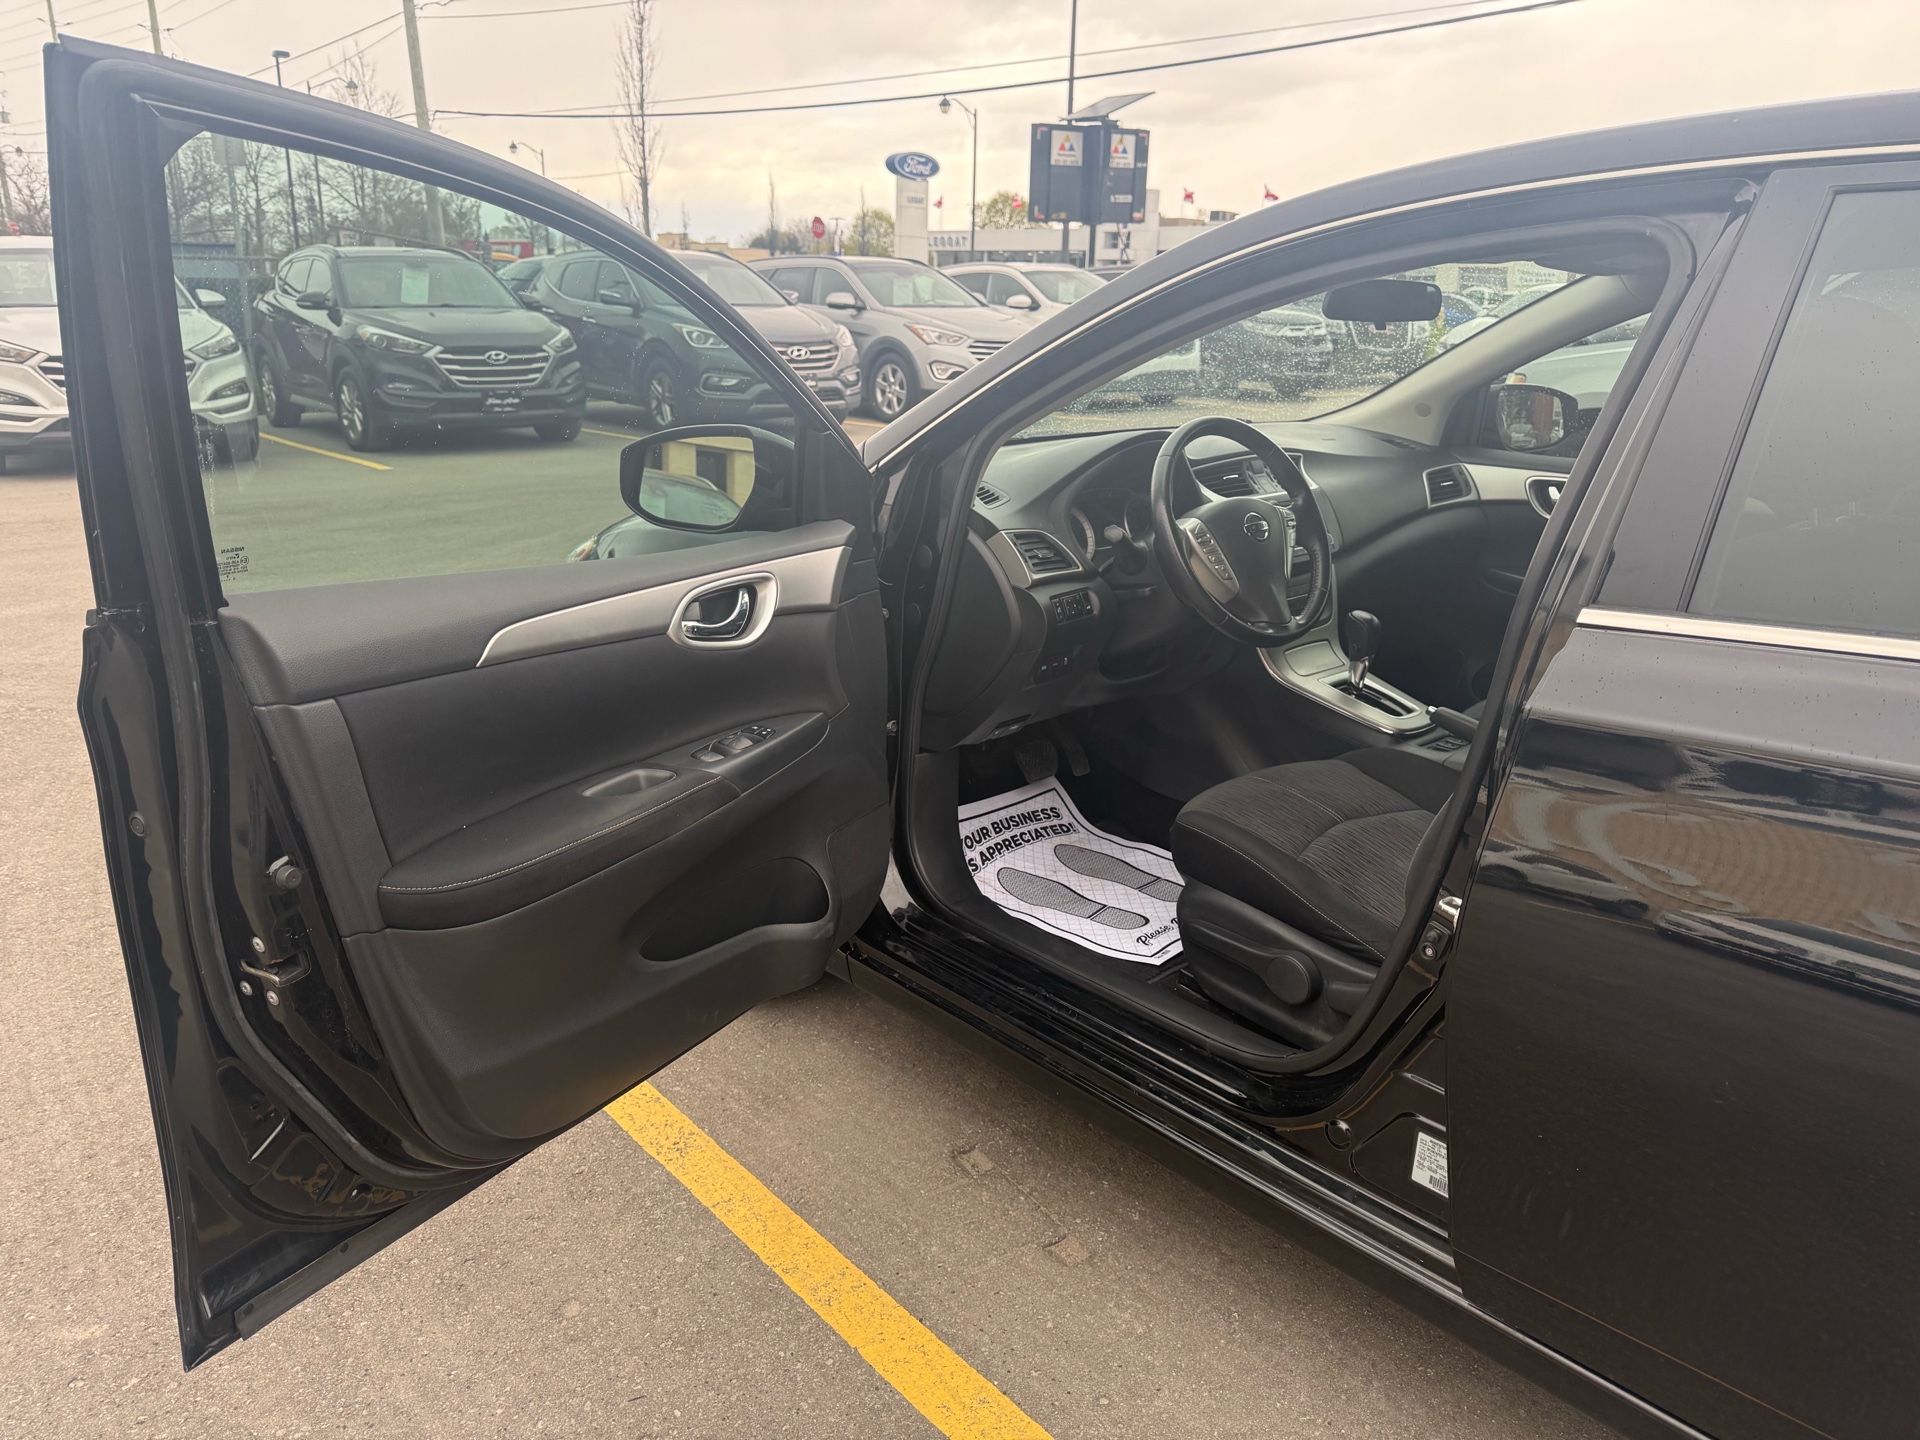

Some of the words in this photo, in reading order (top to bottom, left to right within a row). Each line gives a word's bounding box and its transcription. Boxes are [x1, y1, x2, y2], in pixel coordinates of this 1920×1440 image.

[903, 156, 932, 175] Ford
[962, 826, 991, 850] OUR
[990, 807, 1061, 835] BUSINESS
[968, 857, 979, 873] S
[979, 822, 1077, 867] APPRECIATED!
